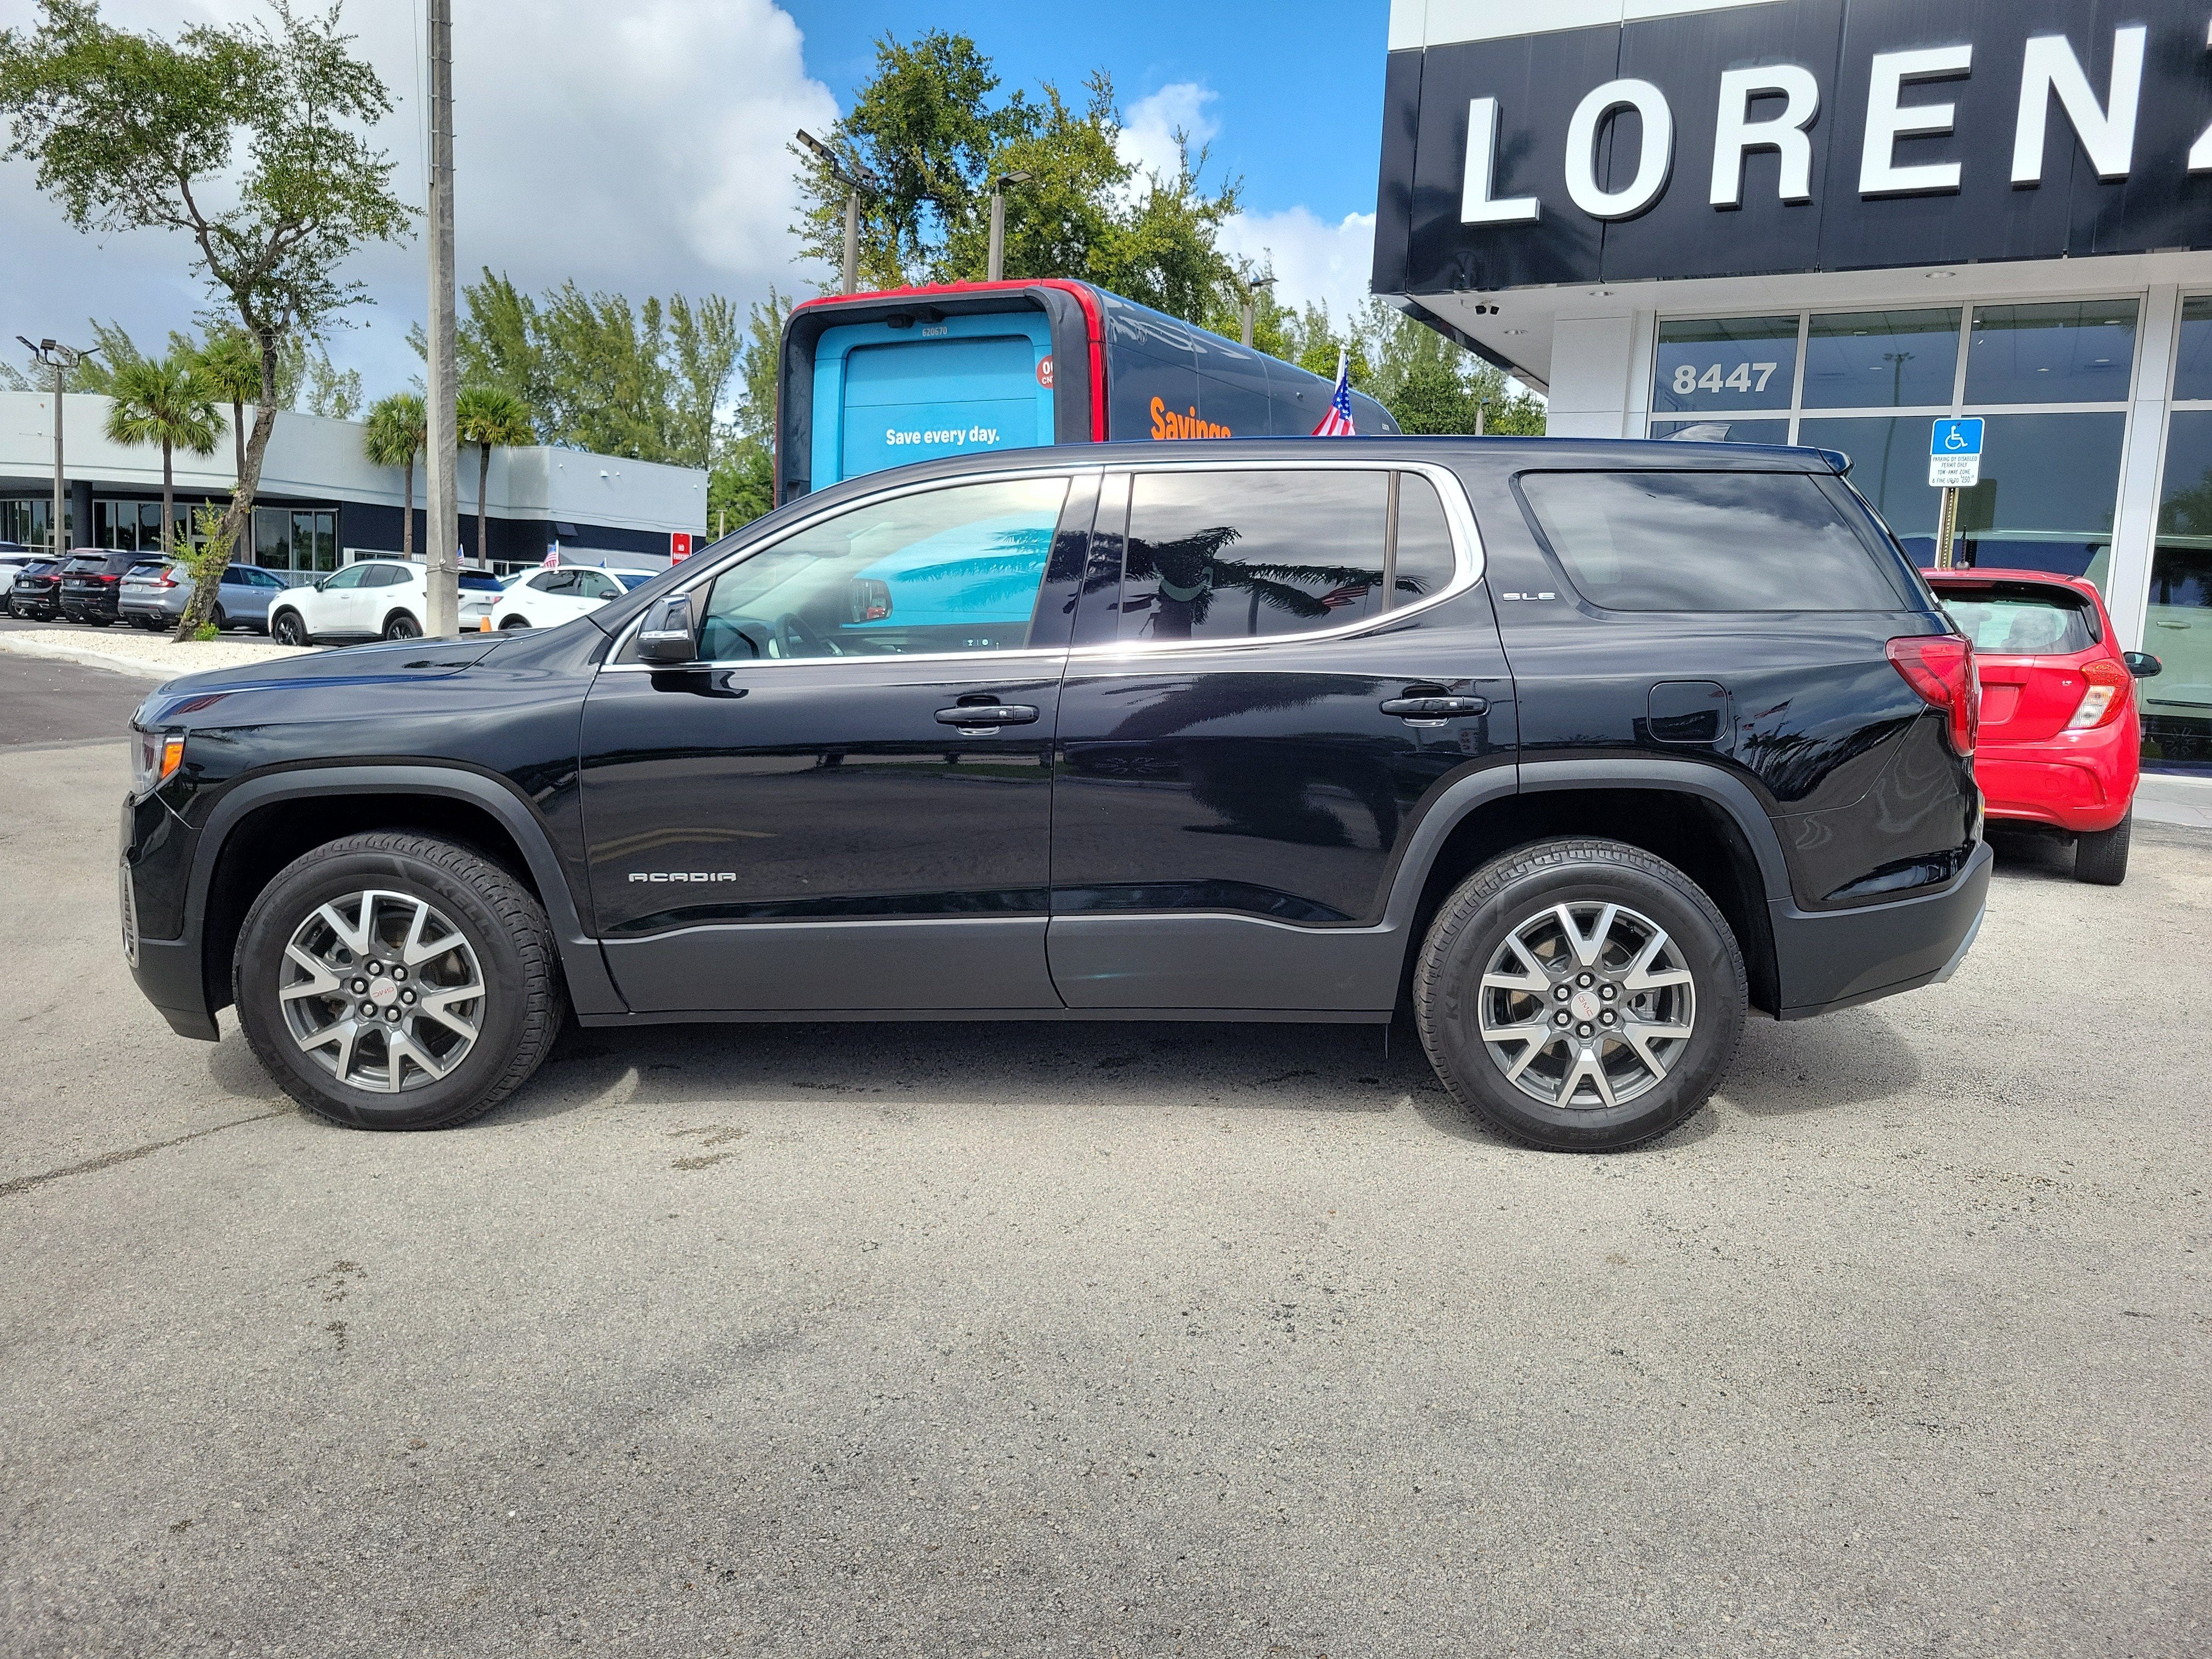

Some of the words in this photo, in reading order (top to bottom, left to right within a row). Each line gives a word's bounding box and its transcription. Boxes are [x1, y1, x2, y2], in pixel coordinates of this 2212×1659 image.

[1461, 20, 2212, 225] LOREN
[922, 326, 947, 337] 620670
[1673, 363, 1778, 394] 8447
[886, 428, 921, 445] Save
[924, 430, 966, 445] every
[969, 425, 1000, 445] day.
[1503, 592, 1555, 601] SLE
[628, 872, 737, 882] ACADIA
[432, 878, 500, 946] KELLY
[373, 986, 394, 997] GMC
[1578, 996, 1593, 1017] GMC
